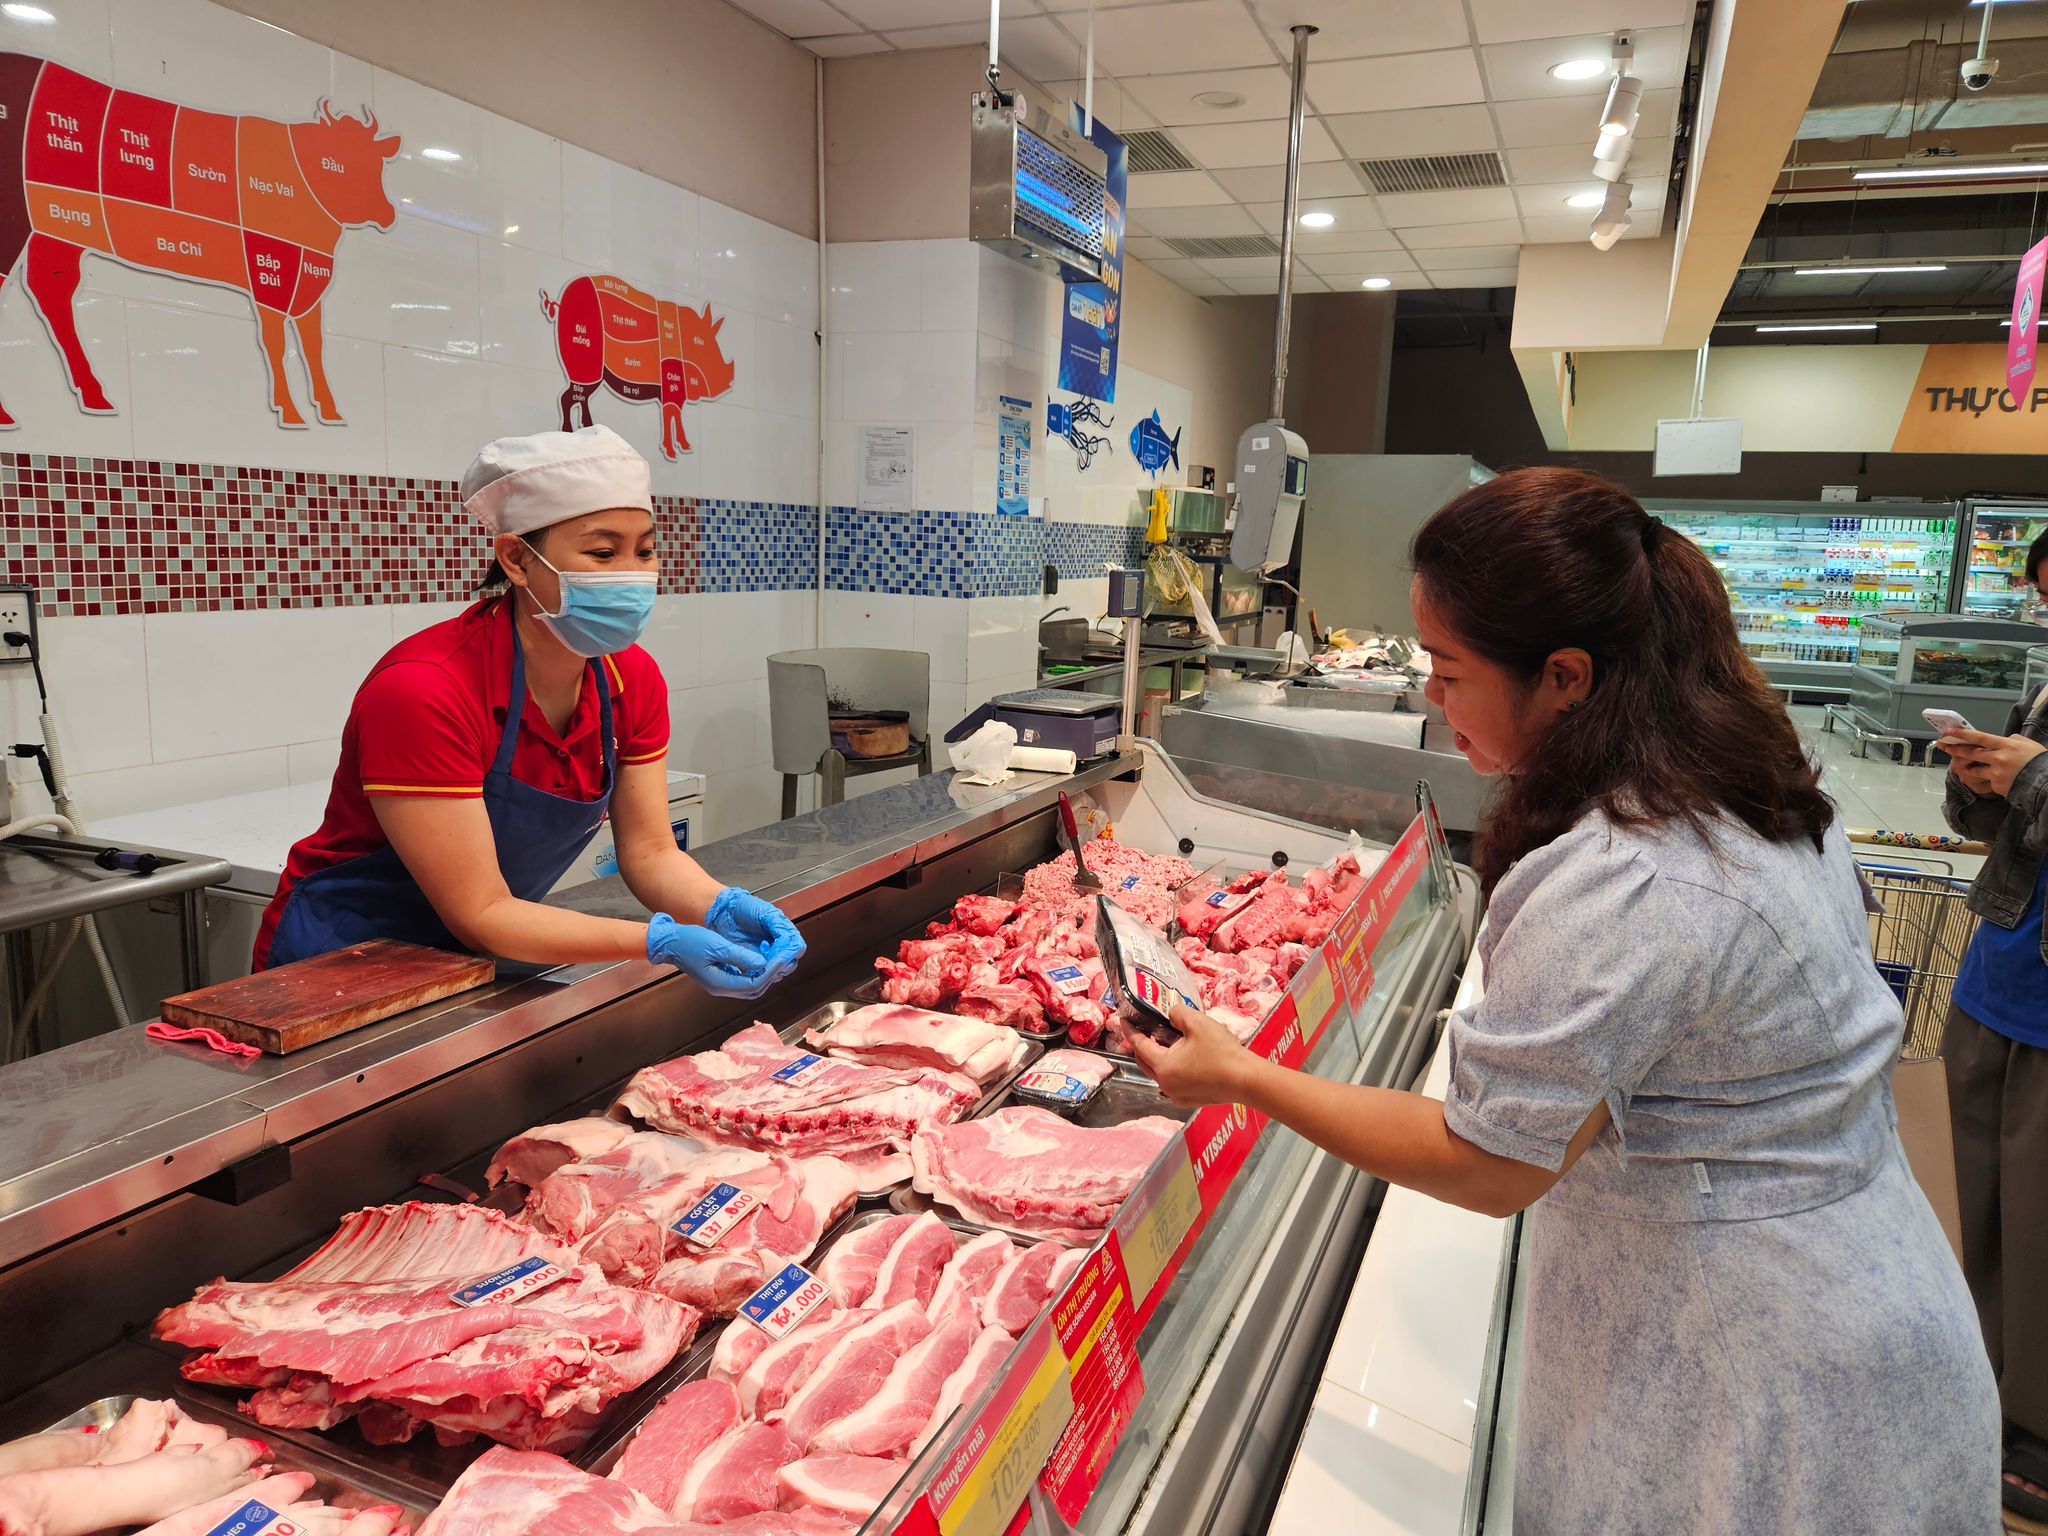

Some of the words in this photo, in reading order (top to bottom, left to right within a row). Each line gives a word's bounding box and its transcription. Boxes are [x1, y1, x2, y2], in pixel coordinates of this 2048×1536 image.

[46, 111, 79, 134] Thịt
[47, 133, 83, 153] thăn
[120, 128, 150, 150] Thịt
[119, 148, 154, 171] lưng
[321, 156, 345, 174] Đầu
[188, 163, 227, 183] Sườn
[249, 176, 273, 195] Nạc
[275, 181, 294, 198] Vai
[48, 203, 91, 227] Bụng
[156, 237, 176, 252] Ba
[256, 253, 281, 271] Bắp
[303, 261, 331, 279] Nạm
[259, 272, 281, 287] Đùi
[572, 335, 591, 348] mông
[623, 385, 631, 394] Ba
[1925, 387, 2019, 420] THỰC
[1144, 975, 1154, 1003] VISSAN
[1202, 1113, 1235, 1169] VISSAN
[702, 1203, 720, 1218] HEO
[496, 1275, 515, 1286] HEO
[500, 1265, 522, 1278] NON
[1078, 1263, 1100, 1303] TRƯỜNG
[758, 1286, 774, 1301] THỊT
[772, 1288, 787, 1302] HEO
[932, 1450, 970, 1505] Khuyến
[967, 1423, 987, 1457] mãi
